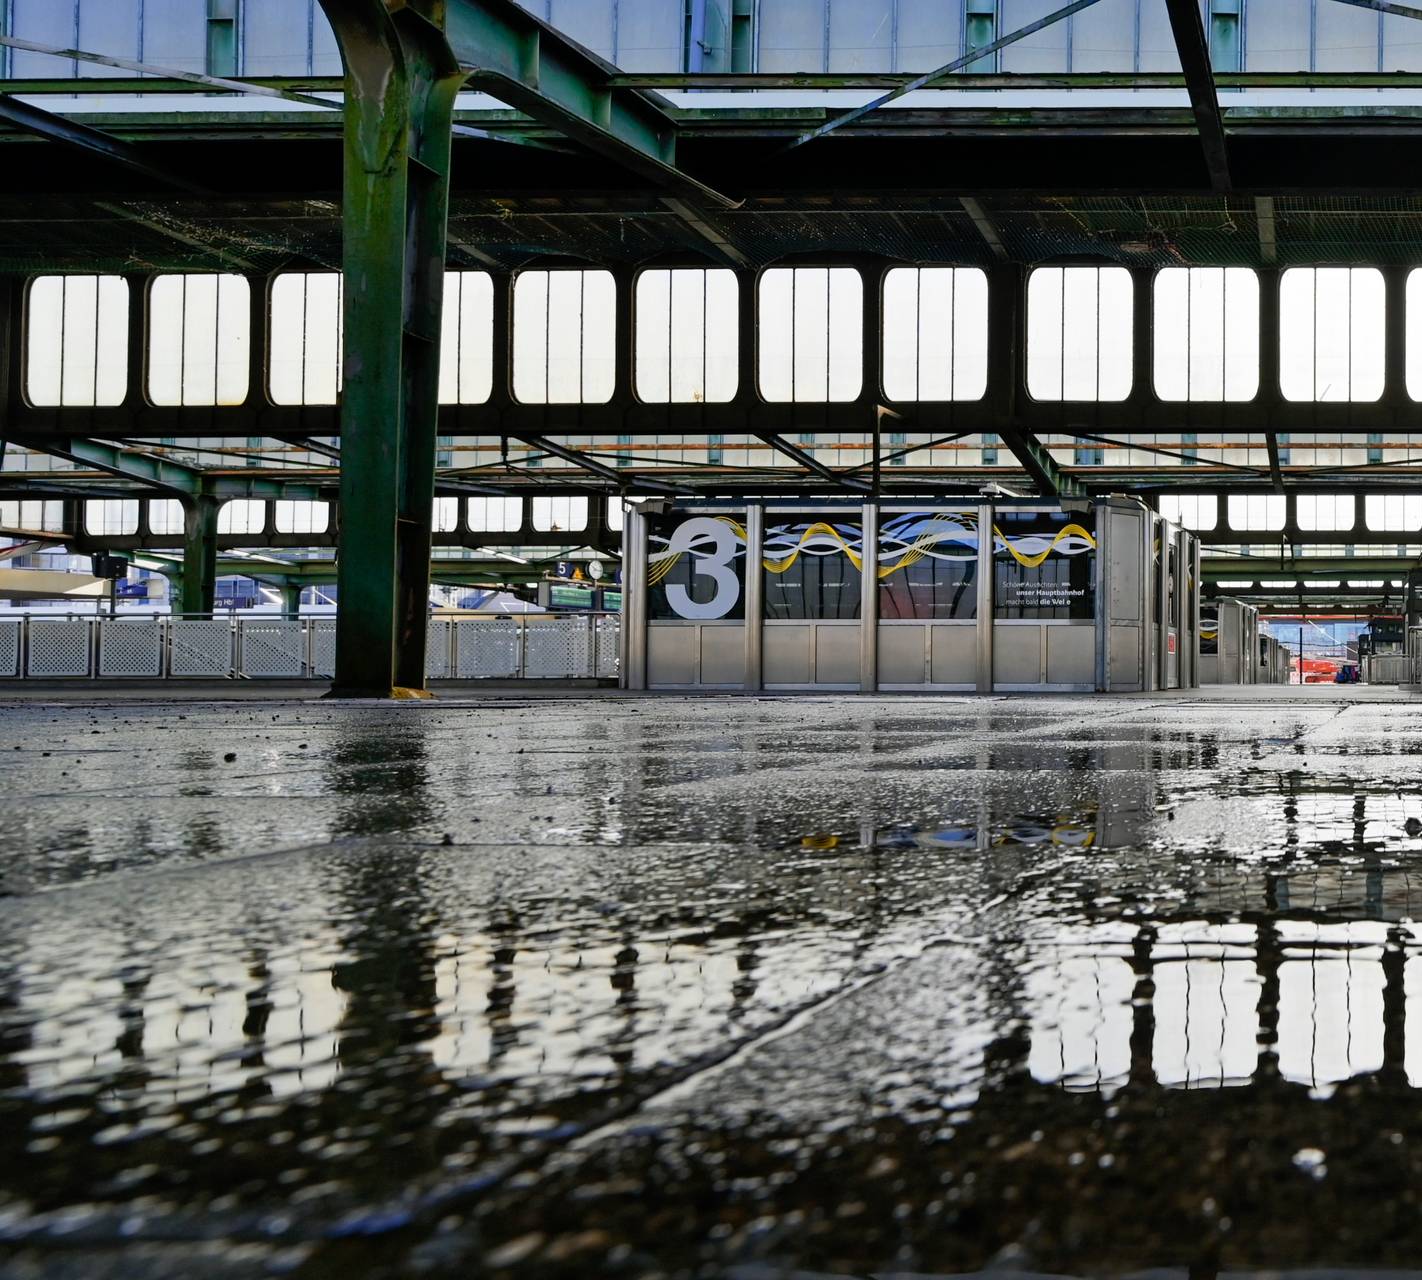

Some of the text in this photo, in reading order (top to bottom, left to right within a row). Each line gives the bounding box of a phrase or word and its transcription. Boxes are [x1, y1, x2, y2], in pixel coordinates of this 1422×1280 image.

[558, 562, 567, 575] 5
[665, 516, 740, 620] 3
[1036, 589, 1085, 597] Hauptbahnhof
